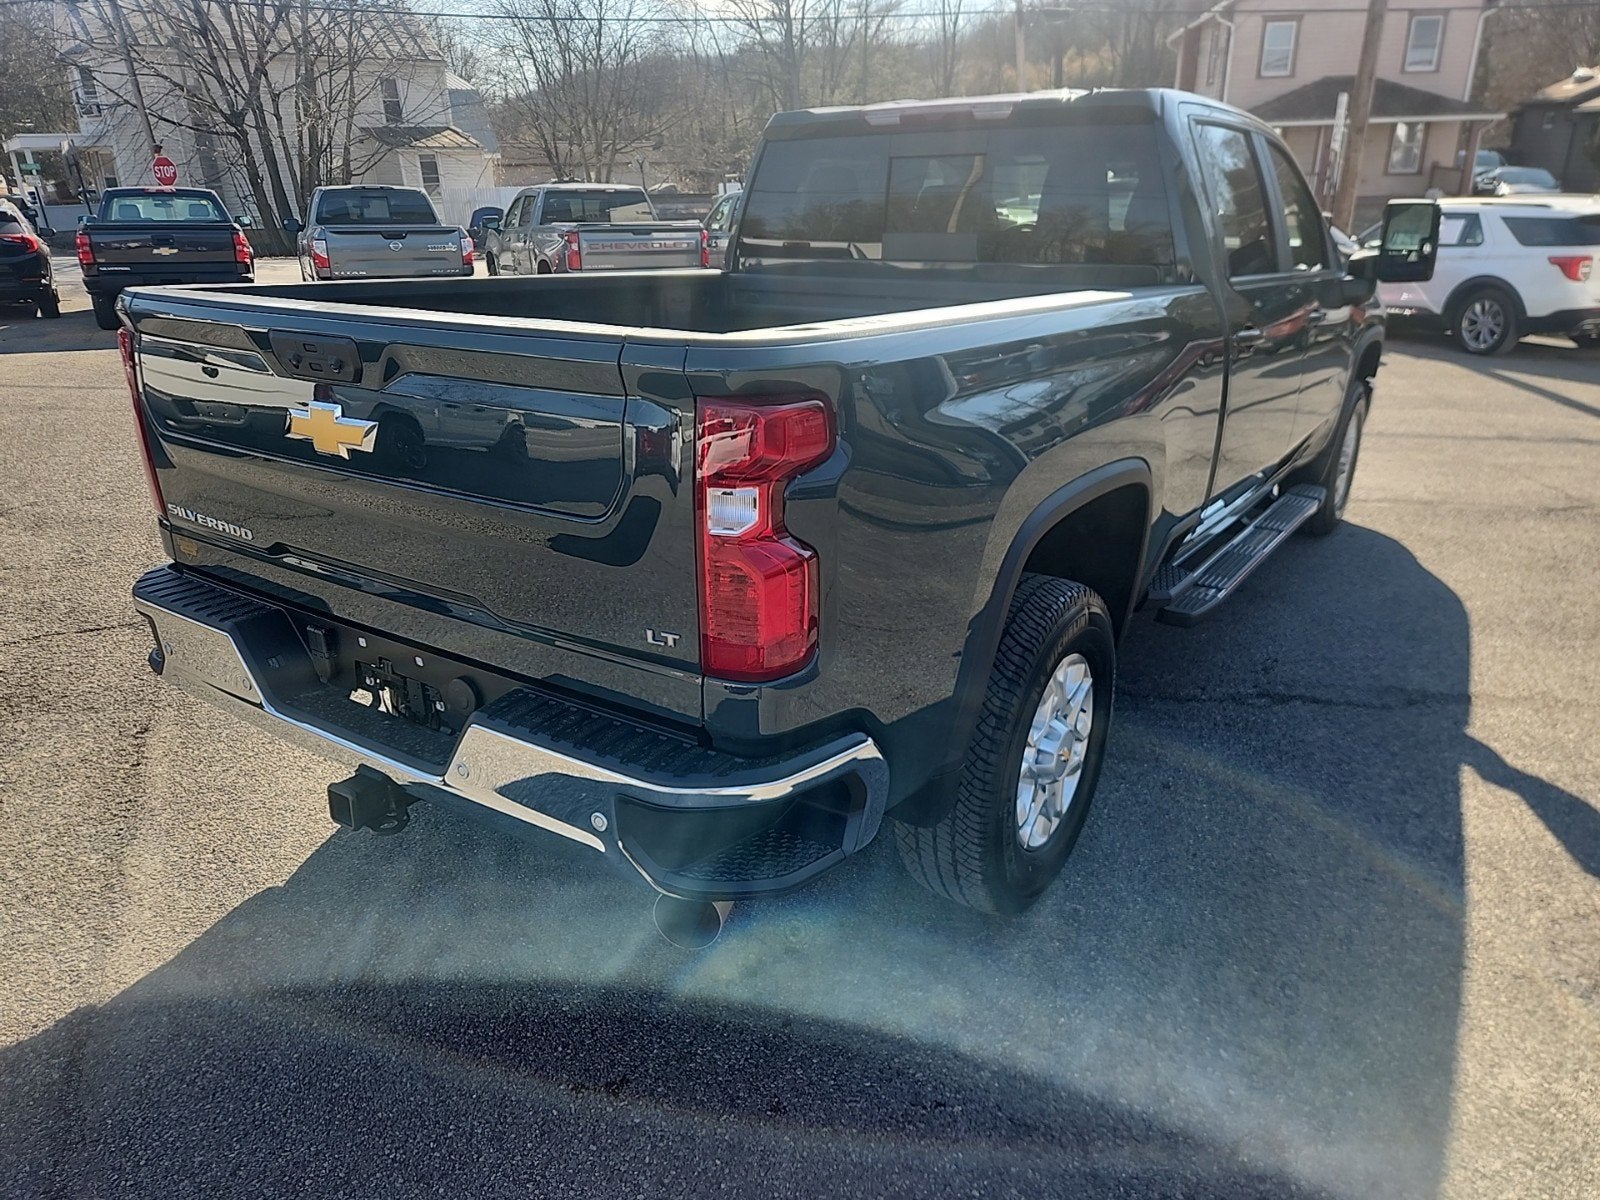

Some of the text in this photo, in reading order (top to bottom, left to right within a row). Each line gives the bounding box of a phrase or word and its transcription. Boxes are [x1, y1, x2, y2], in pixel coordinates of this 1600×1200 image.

[154, 165, 175, 178] STOP
[588, 240, 691, 251] CHEVROLET
[167, 503, 254, 541] SILVERADO
[645, 628, 681, 648] LT
